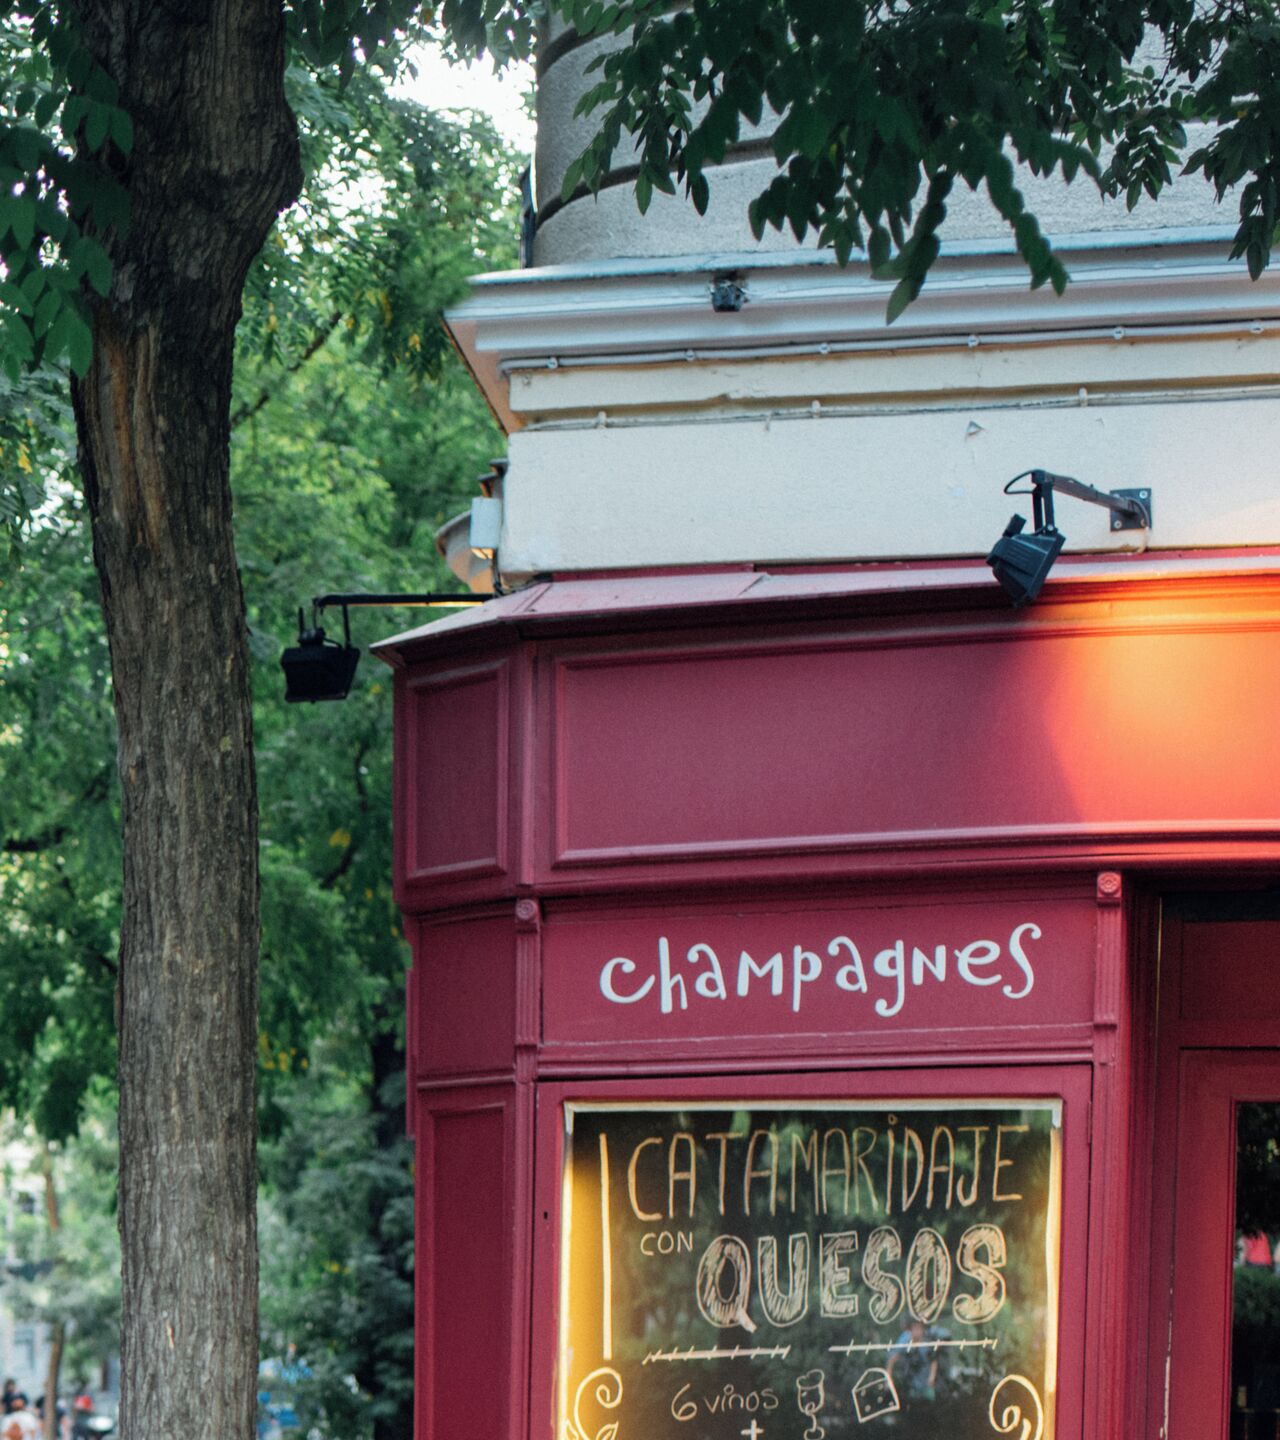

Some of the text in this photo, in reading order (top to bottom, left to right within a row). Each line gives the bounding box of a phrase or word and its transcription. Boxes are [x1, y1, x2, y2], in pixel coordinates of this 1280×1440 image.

[640, 1231, 694, 1257] CON
[696, 1224, 1007, 1333] QUESOS
[670, 1384, 698, 1421] 6
